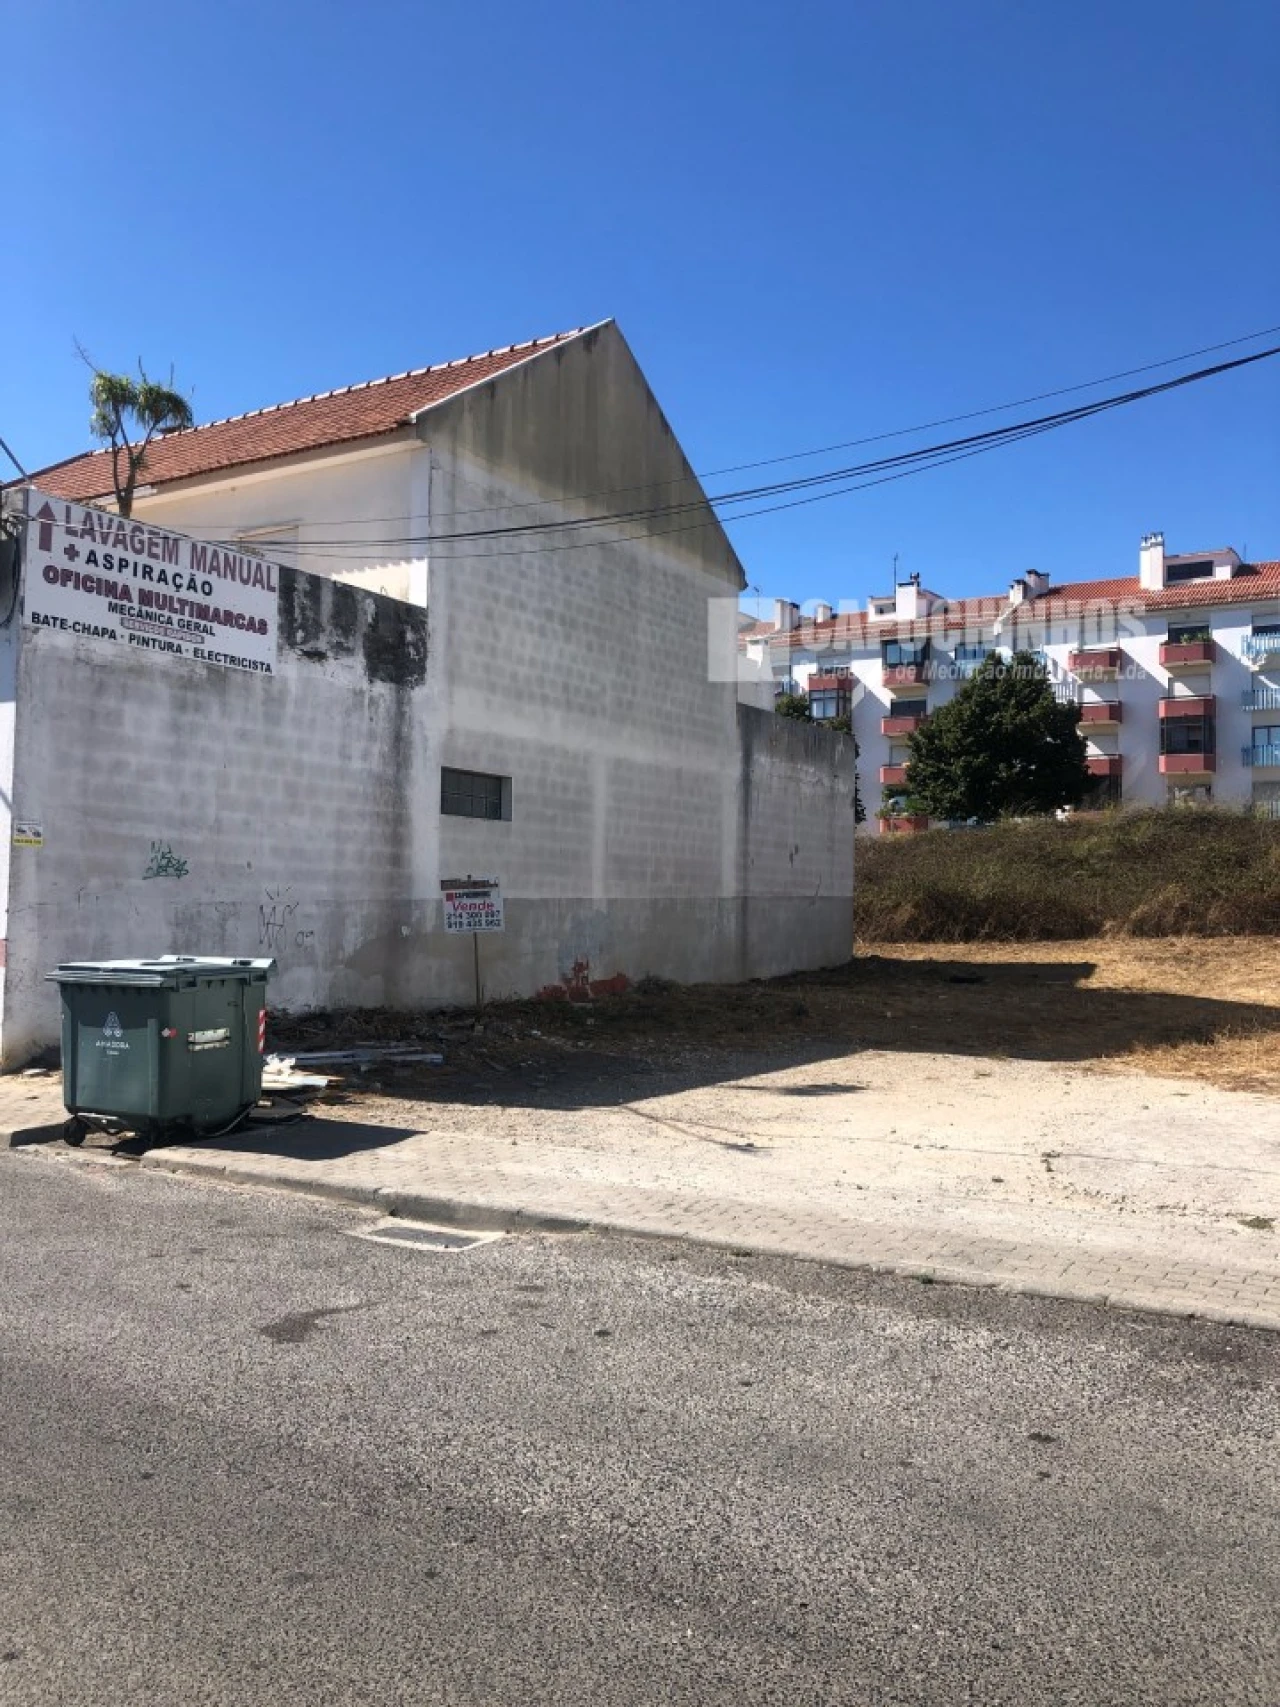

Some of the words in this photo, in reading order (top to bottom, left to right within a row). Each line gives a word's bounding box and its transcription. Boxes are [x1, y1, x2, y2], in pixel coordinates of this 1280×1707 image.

[64, 504, 180, 566] LAVAGEM
[190, 541, 276, 592] MANUAL
[85, 549, 213, 596] ASPIRAÇÃO
[43, 565, 133, 603] OFICINA
[138, 587, 269, 635] MULTIMARCAS
[177, 618, 216, 636] GERAL
[31, 611, 117, 640] BATE-CHAPA
[129, 632, 183, 655] PINTURA
[193, 646, 272, 674] ELECTRICISTA
[453, 900, 495, 911] Vende
